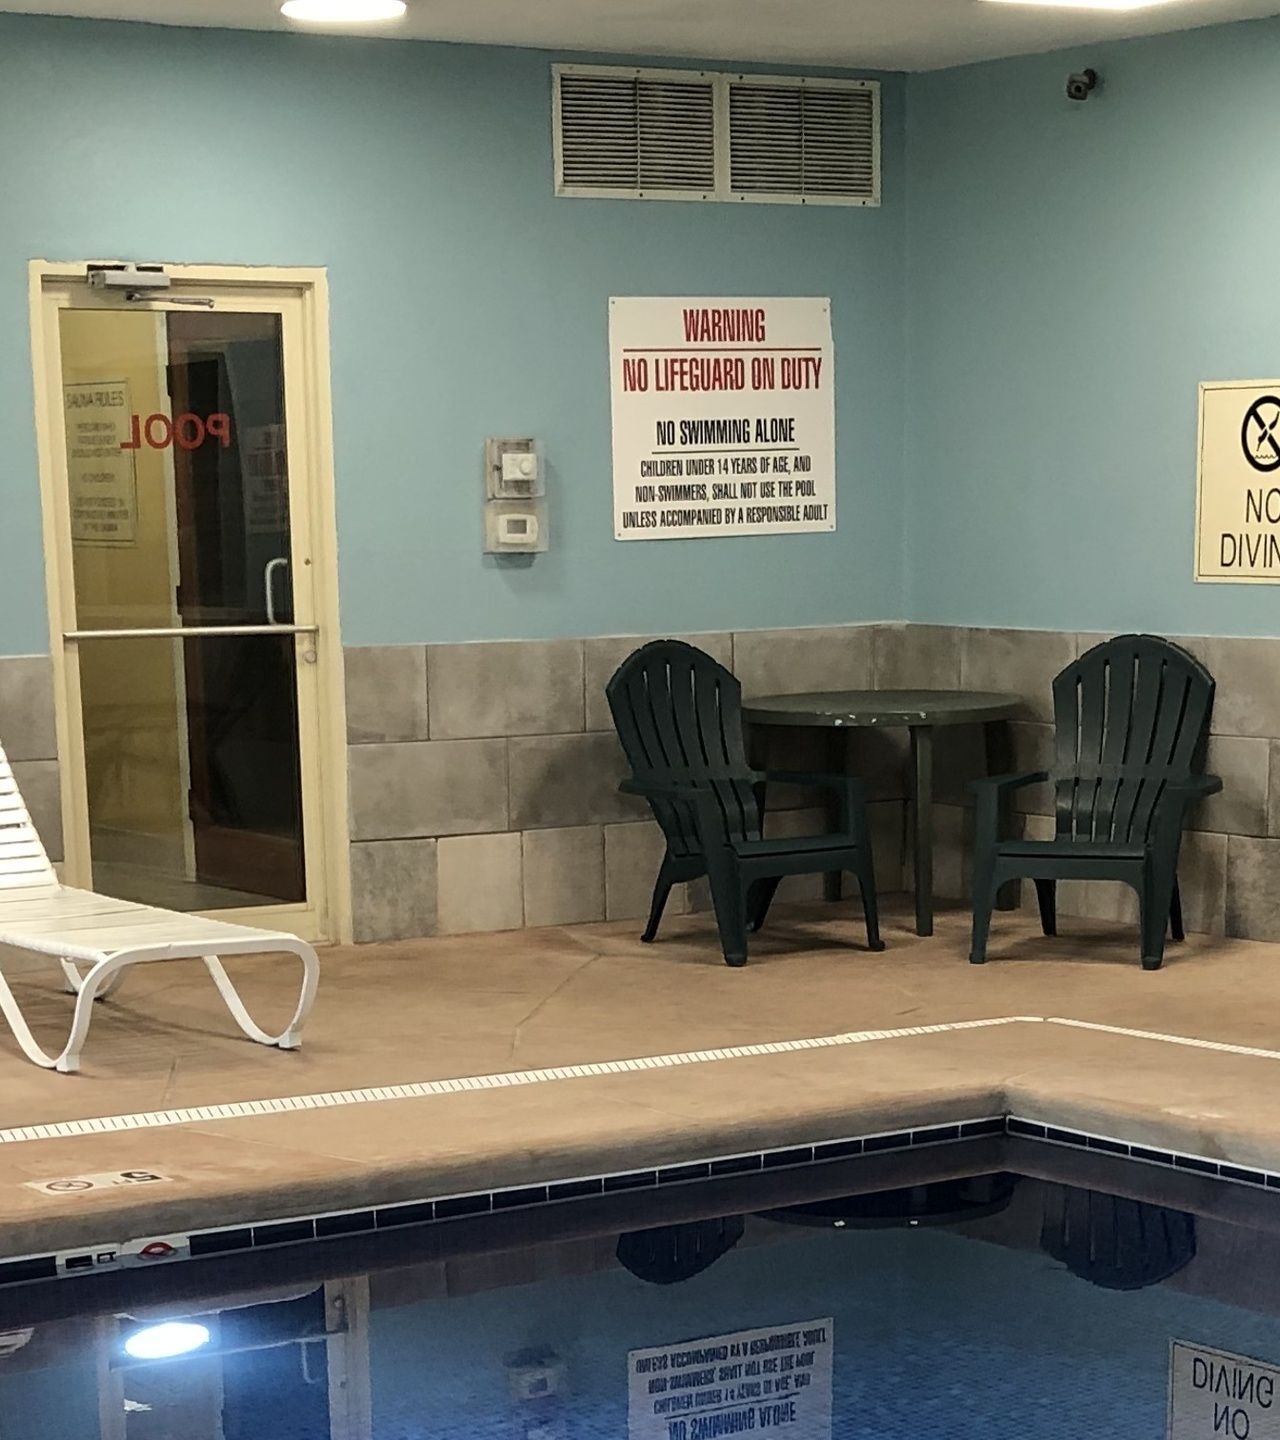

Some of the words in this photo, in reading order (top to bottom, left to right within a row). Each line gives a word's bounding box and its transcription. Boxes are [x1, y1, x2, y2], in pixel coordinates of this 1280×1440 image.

[683, 309, 765, 342] WARNING
[622, 358, 648, 391] NO
[655, 357, 745, 391] LIFEGUARD
[751, 357, 774, 389] ON
[780, 357, 822, 389] DUTY
[656, 420, 674, 445] NO
[680, 419, 749, 445] SWIMMING
[754, 418, 795, 443] ALONE
[640, 459, 682, 477] CHILDREN
[685, 459, 714, 475] UNDER
[717, 458, 728, 474] 14
[731, 457, 756, 474] YEARS
[760, 457, 770, 473] OF
[772, 456, 791, 475] AGE,
[793, 456, 810, 472] AND
[635, 483, 709, 504] NON-SWIMMERS,
[712, 483, 737, 500] SHALL
[740, 482, 757, 498] NOT
[760, 481, 775, 498] USE
[778, 481, 792, 497] THE
[794, 480, 815, 497] POOL
[622, 510, 656, 528] UNLESS
[659, 508, 721, 526] ACCOMPANIED
[725, 507, 735, 524] BY
[737, 507, 743, 523] A
[746, 505, 799, 523] RESPONSIBLE
[802, 504, 828, 521] ADULT
